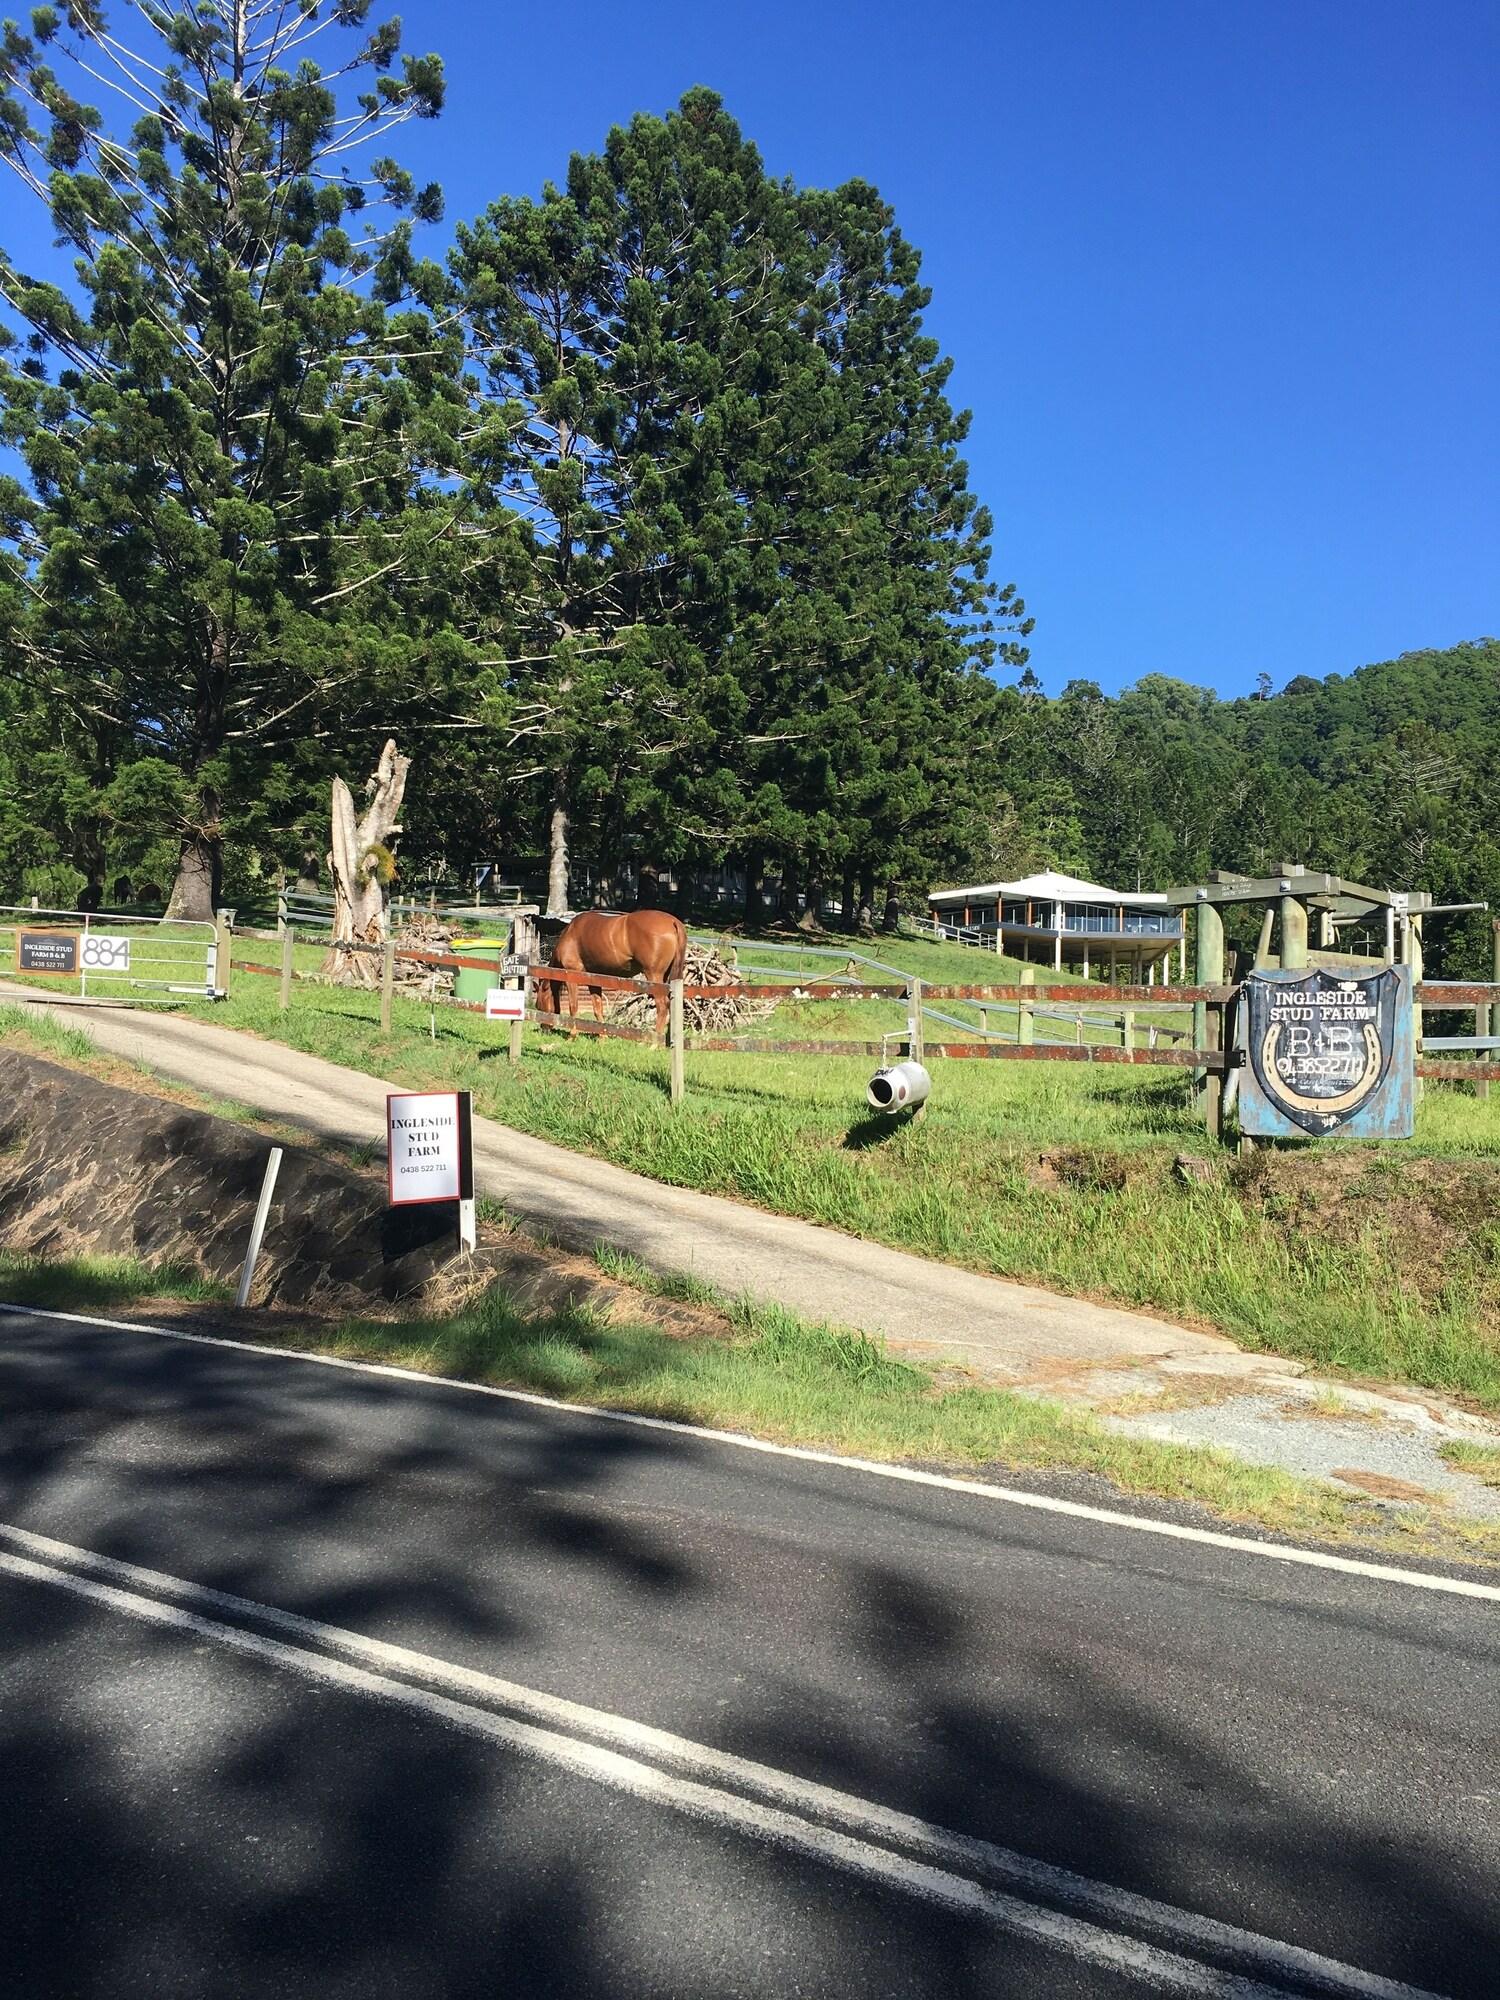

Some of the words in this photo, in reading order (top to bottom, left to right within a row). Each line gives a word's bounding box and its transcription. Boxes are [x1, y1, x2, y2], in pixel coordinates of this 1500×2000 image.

[83, 938, 129, 967] 884
[503, 955, 519, 965] GATE
[1275, 991, 1366, 1005] INGLESIDE
[1270, 1008, 1314, 1021] STUD
[1321, 1007, 1370, 1020] FARM
[1288, 1026, 1311, 1056] B
[1327, 1026, 1353, 1056] B
[408, 1132, 439, 1143] STUD
[408, 1146, 441, 1157] FARM
[400, 1165, 419, 1174] 0438
